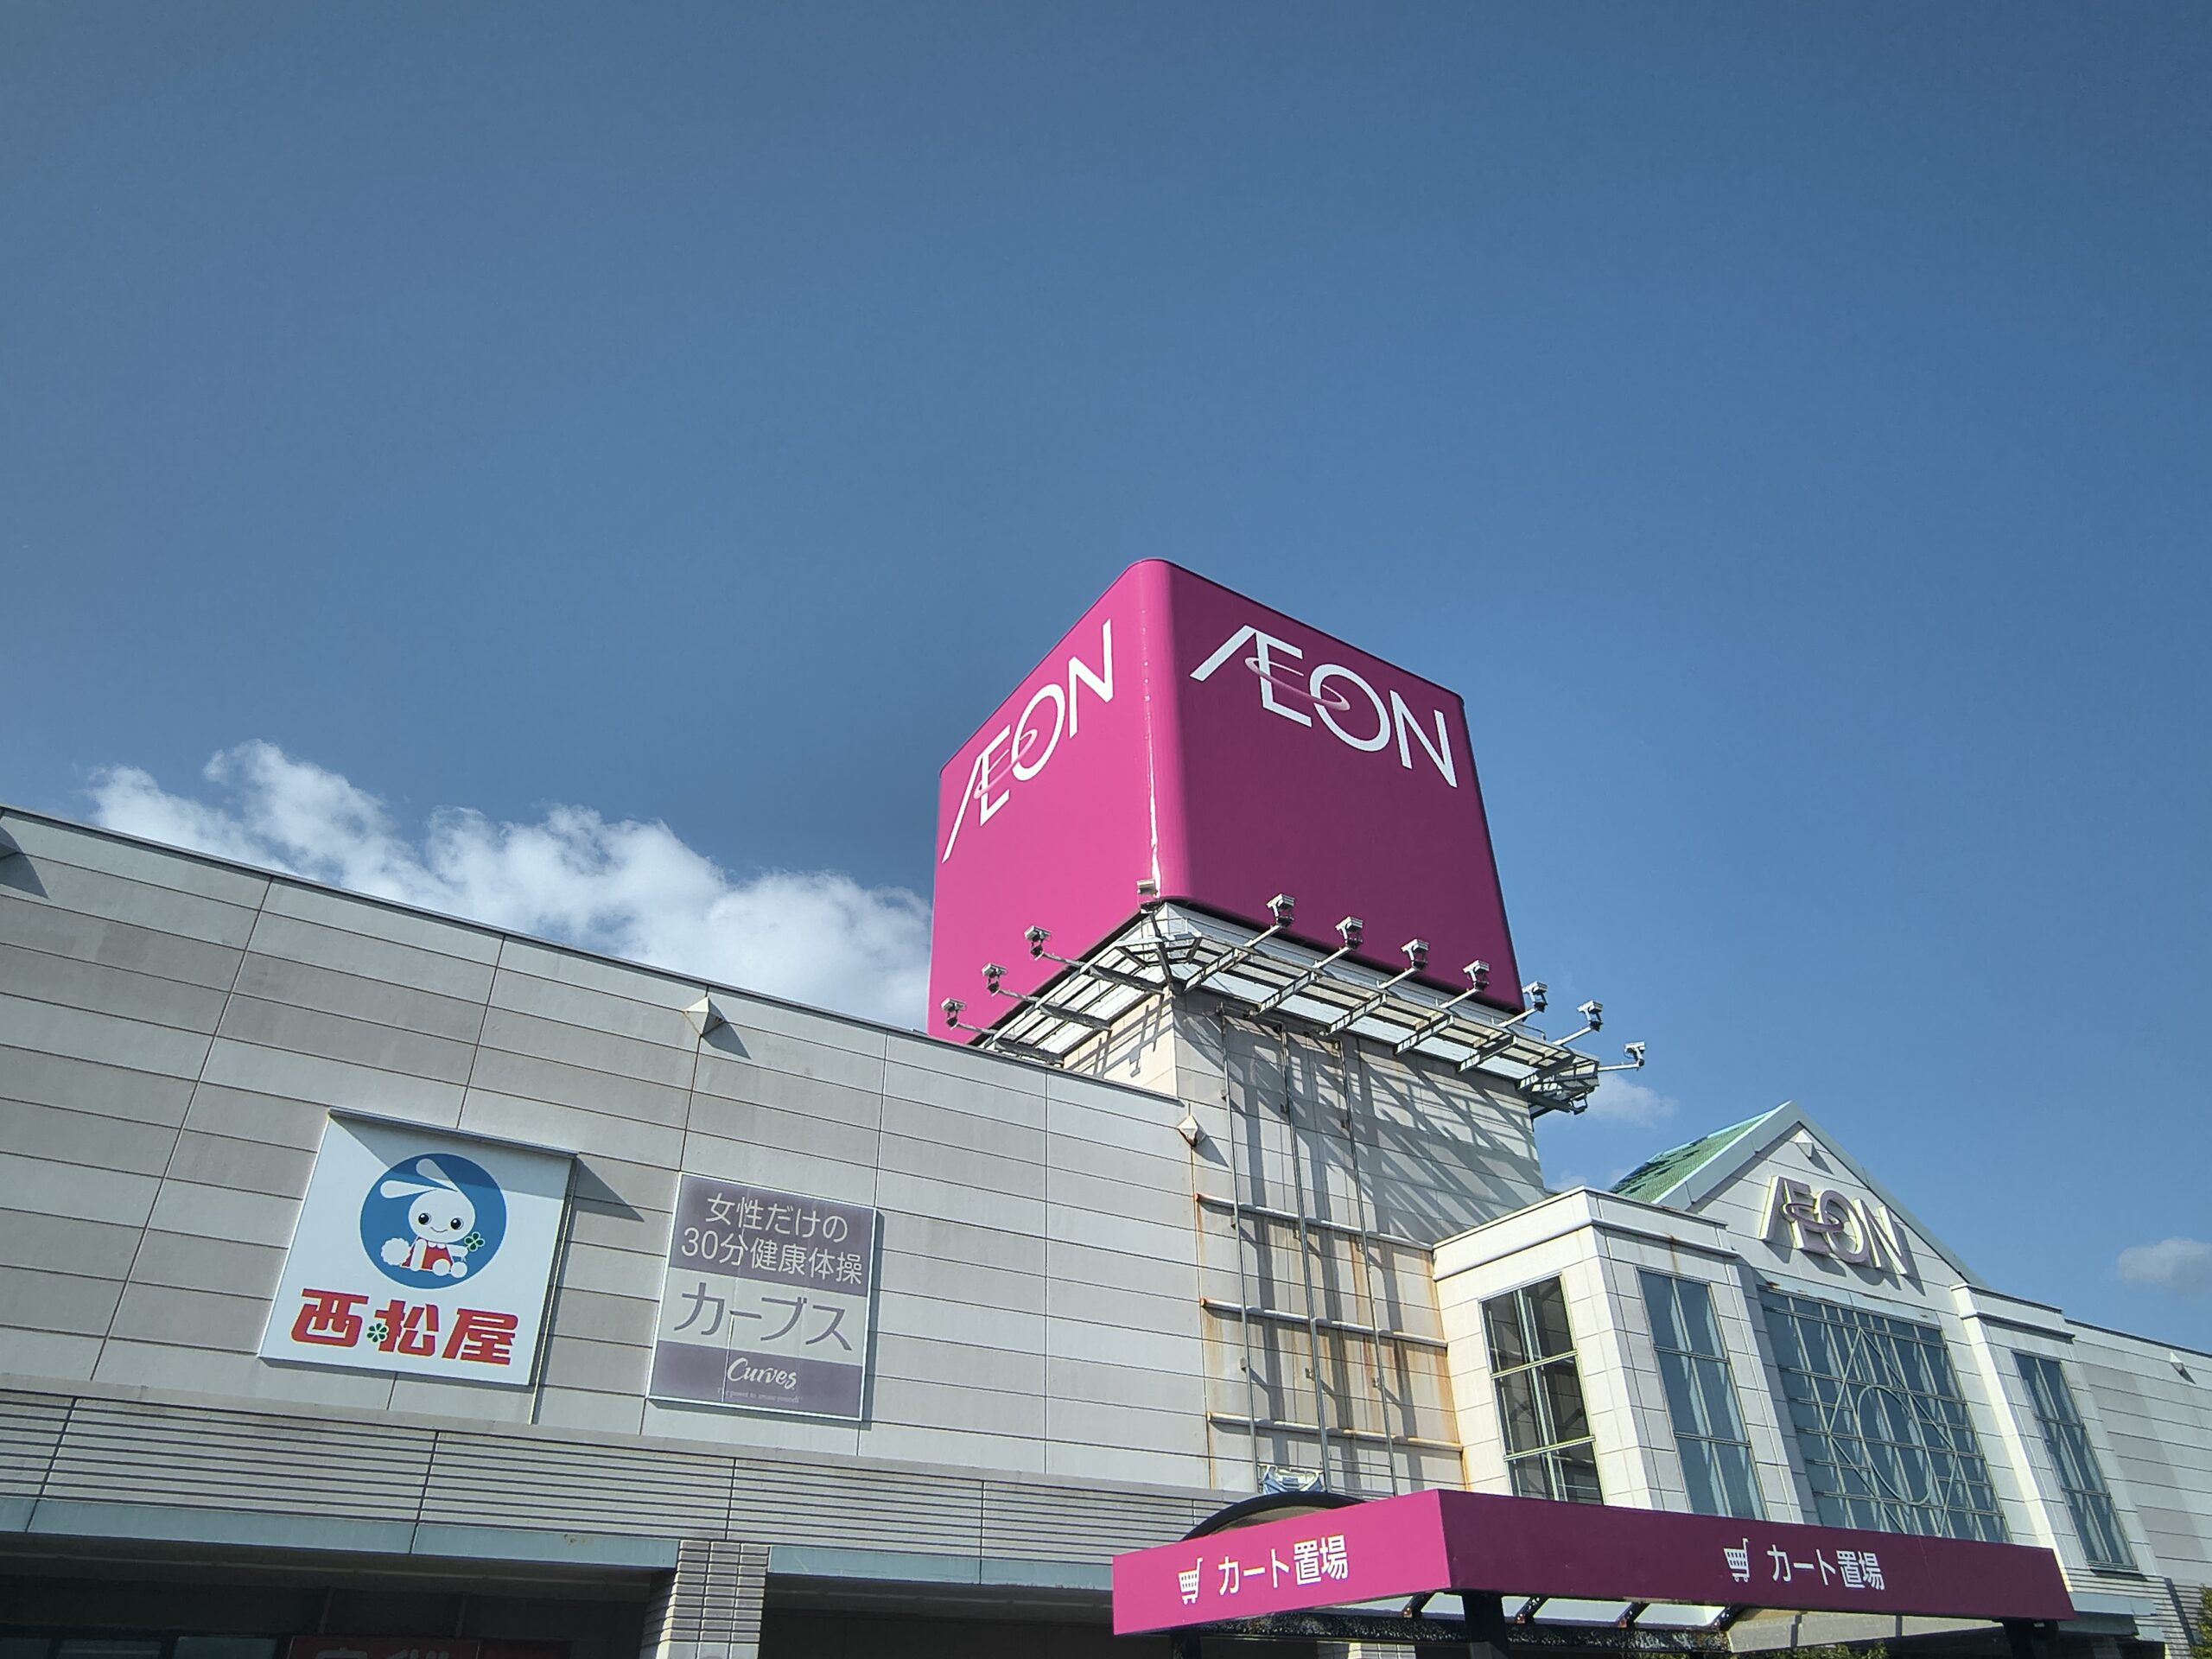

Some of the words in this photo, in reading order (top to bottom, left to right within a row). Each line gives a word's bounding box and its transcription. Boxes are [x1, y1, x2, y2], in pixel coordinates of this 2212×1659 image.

[705, 1192, 848, 1243] 女性だけの
[681, 1227, 862, 1285] 30分健康体操
[291, 1288, 518, 1365] 西松屋
[674, 1282, 853, 1351] カーブス
[727, 1357, 797, 1389] Curves
[1217, 1535, 1348, 1596] カート置場
[1766, 1543, 1885, 1591] カート置場
